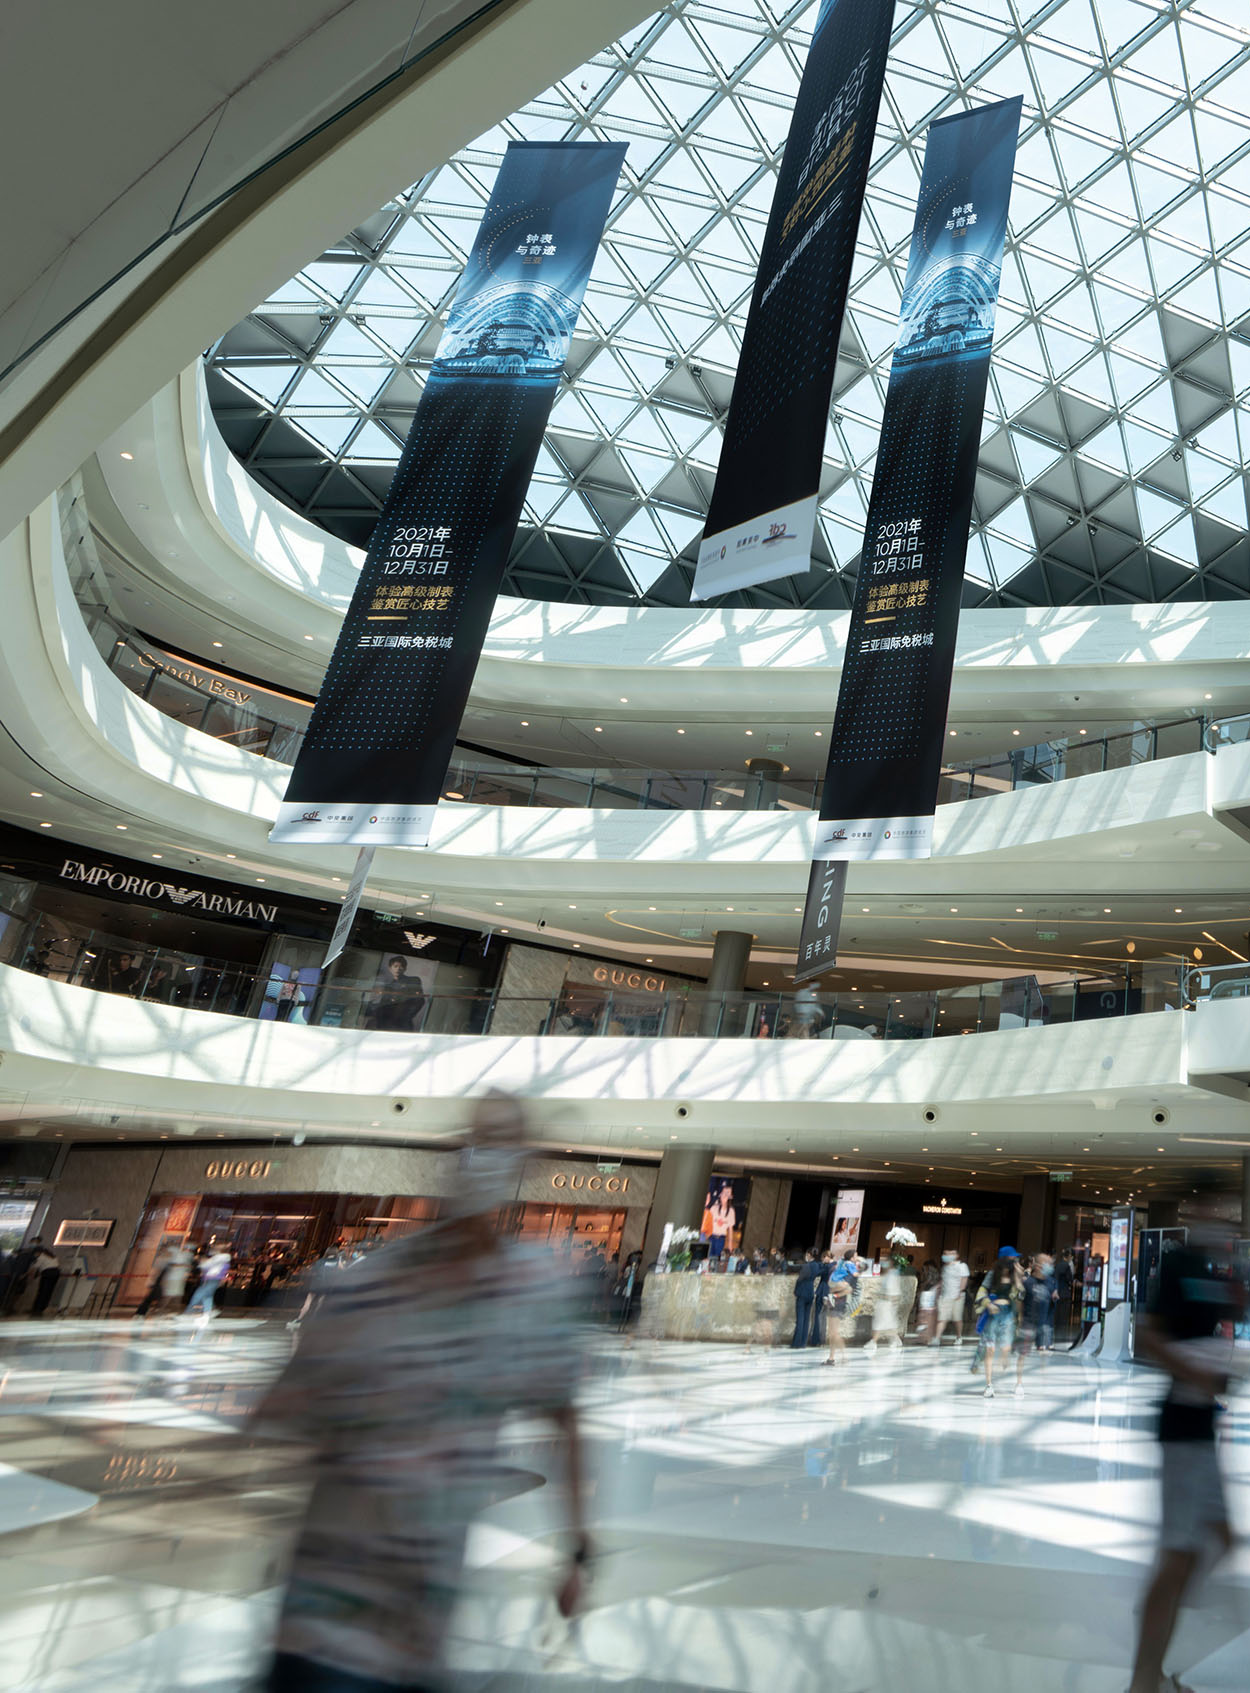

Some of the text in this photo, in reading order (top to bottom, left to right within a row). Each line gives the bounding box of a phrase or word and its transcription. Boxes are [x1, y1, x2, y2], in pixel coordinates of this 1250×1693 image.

[952, 203, 973, 218] 钟表
[944, 214, 977, 231] 与奇迹
[525, 233, 553, 245] 钟表
[515, 244, 557, 257] 与奇迹
[393, 526, 451, 542] 2021年
[877, 518, 922, 539] 2021年
[383, 560, 449, 575] 12月31日
[872, 554, 923, 575] 12月31日
[375, 585, 455, 598] 体验高级制表
[868, 579, 930, 599] 体验高级制表
[370, 597, 449, 611] 鉴赏匠心技艺
[865, 593, 927, 613] 鉴赏匠心技艺
[357, 636, 453, 649] 三亚国际免税城
[859, 632, 934, 653] 三亚国际免税城
[138, 652, 251, 705] Cndy Bay
[302, 810, 320, 819] cdf
[832, 829, 845, 838] cdf
[59, 859, 279, 923] EMPORIO ARMANI
[593, 967, 666, 992] GUCCI
[204, 1160, 272, 1179] GUCCI
[551, 1172, 631, 1193] GUCCI
